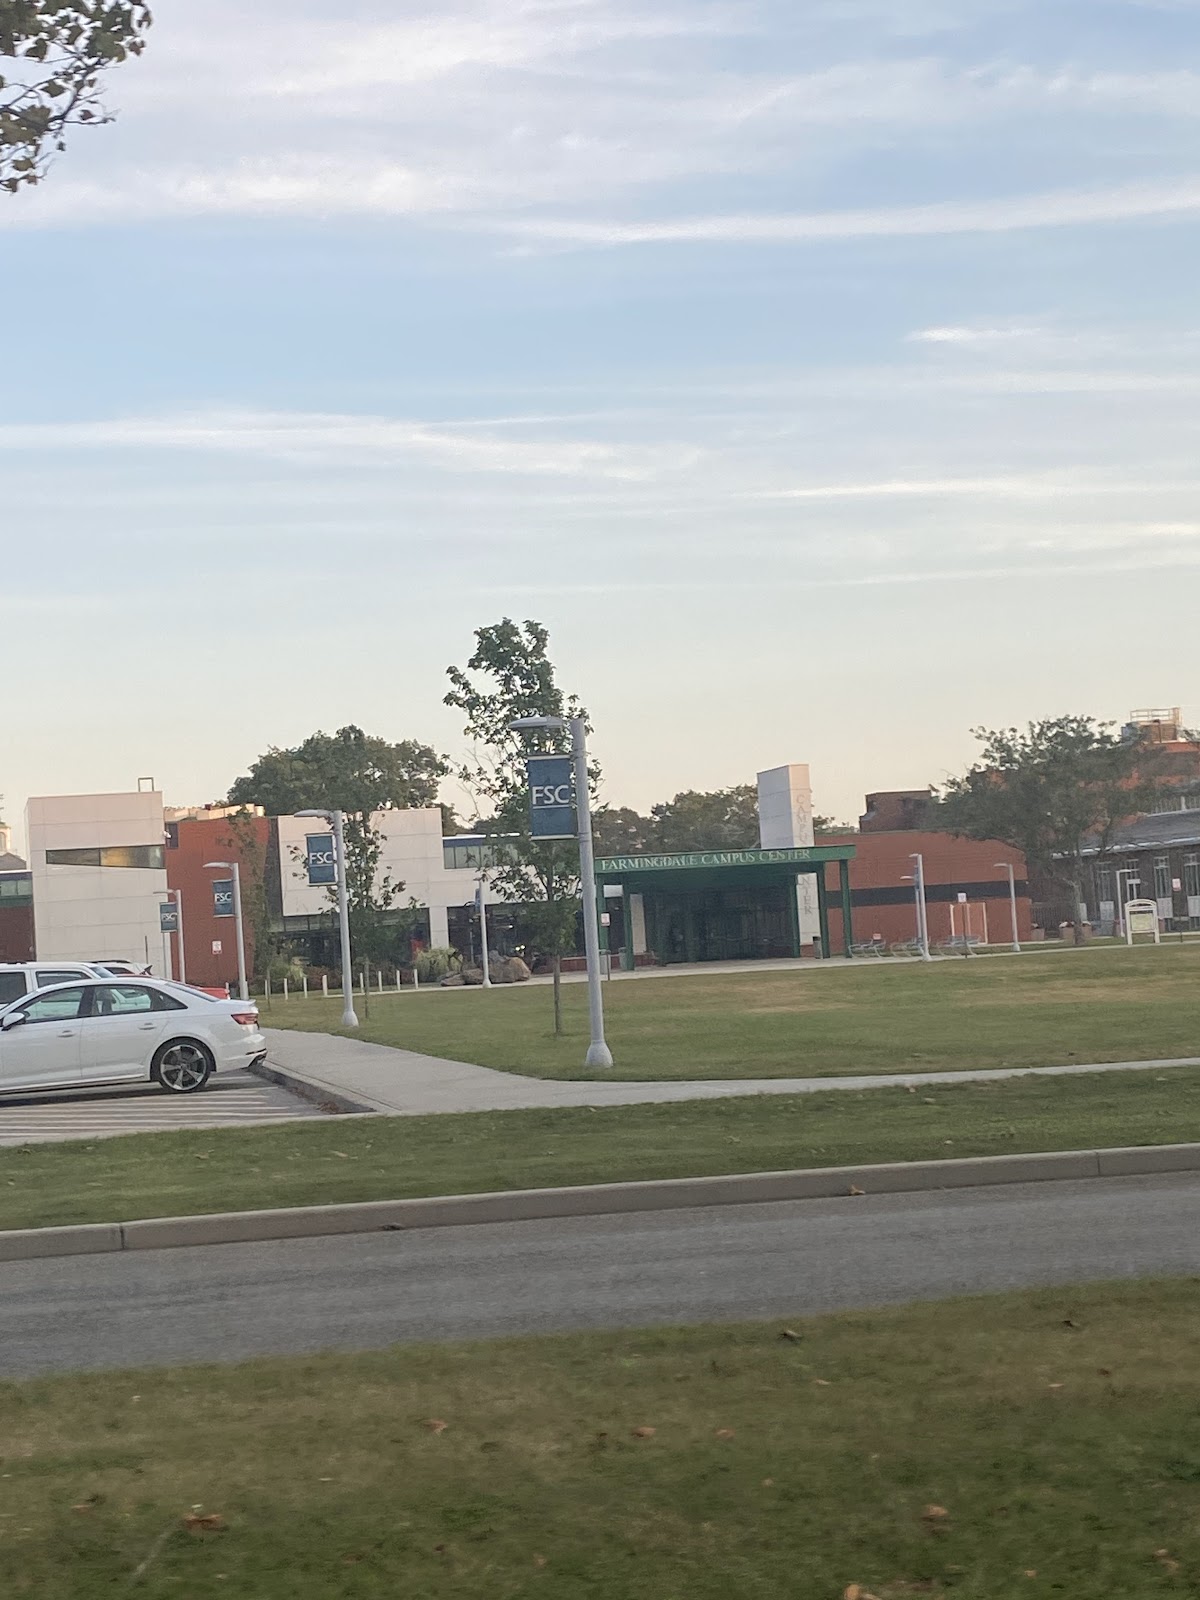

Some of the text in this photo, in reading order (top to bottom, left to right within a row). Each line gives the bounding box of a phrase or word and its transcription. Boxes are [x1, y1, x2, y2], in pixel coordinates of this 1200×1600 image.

[532, 784, 570, 805] FSC
[309, 851, 333, 865] FSC
[601, 848, 811, 871] FARMINGDALE CAMPUS CENTER
[214, 892, 232, 903] FSC
[161, 912, 178, 921] FSC
